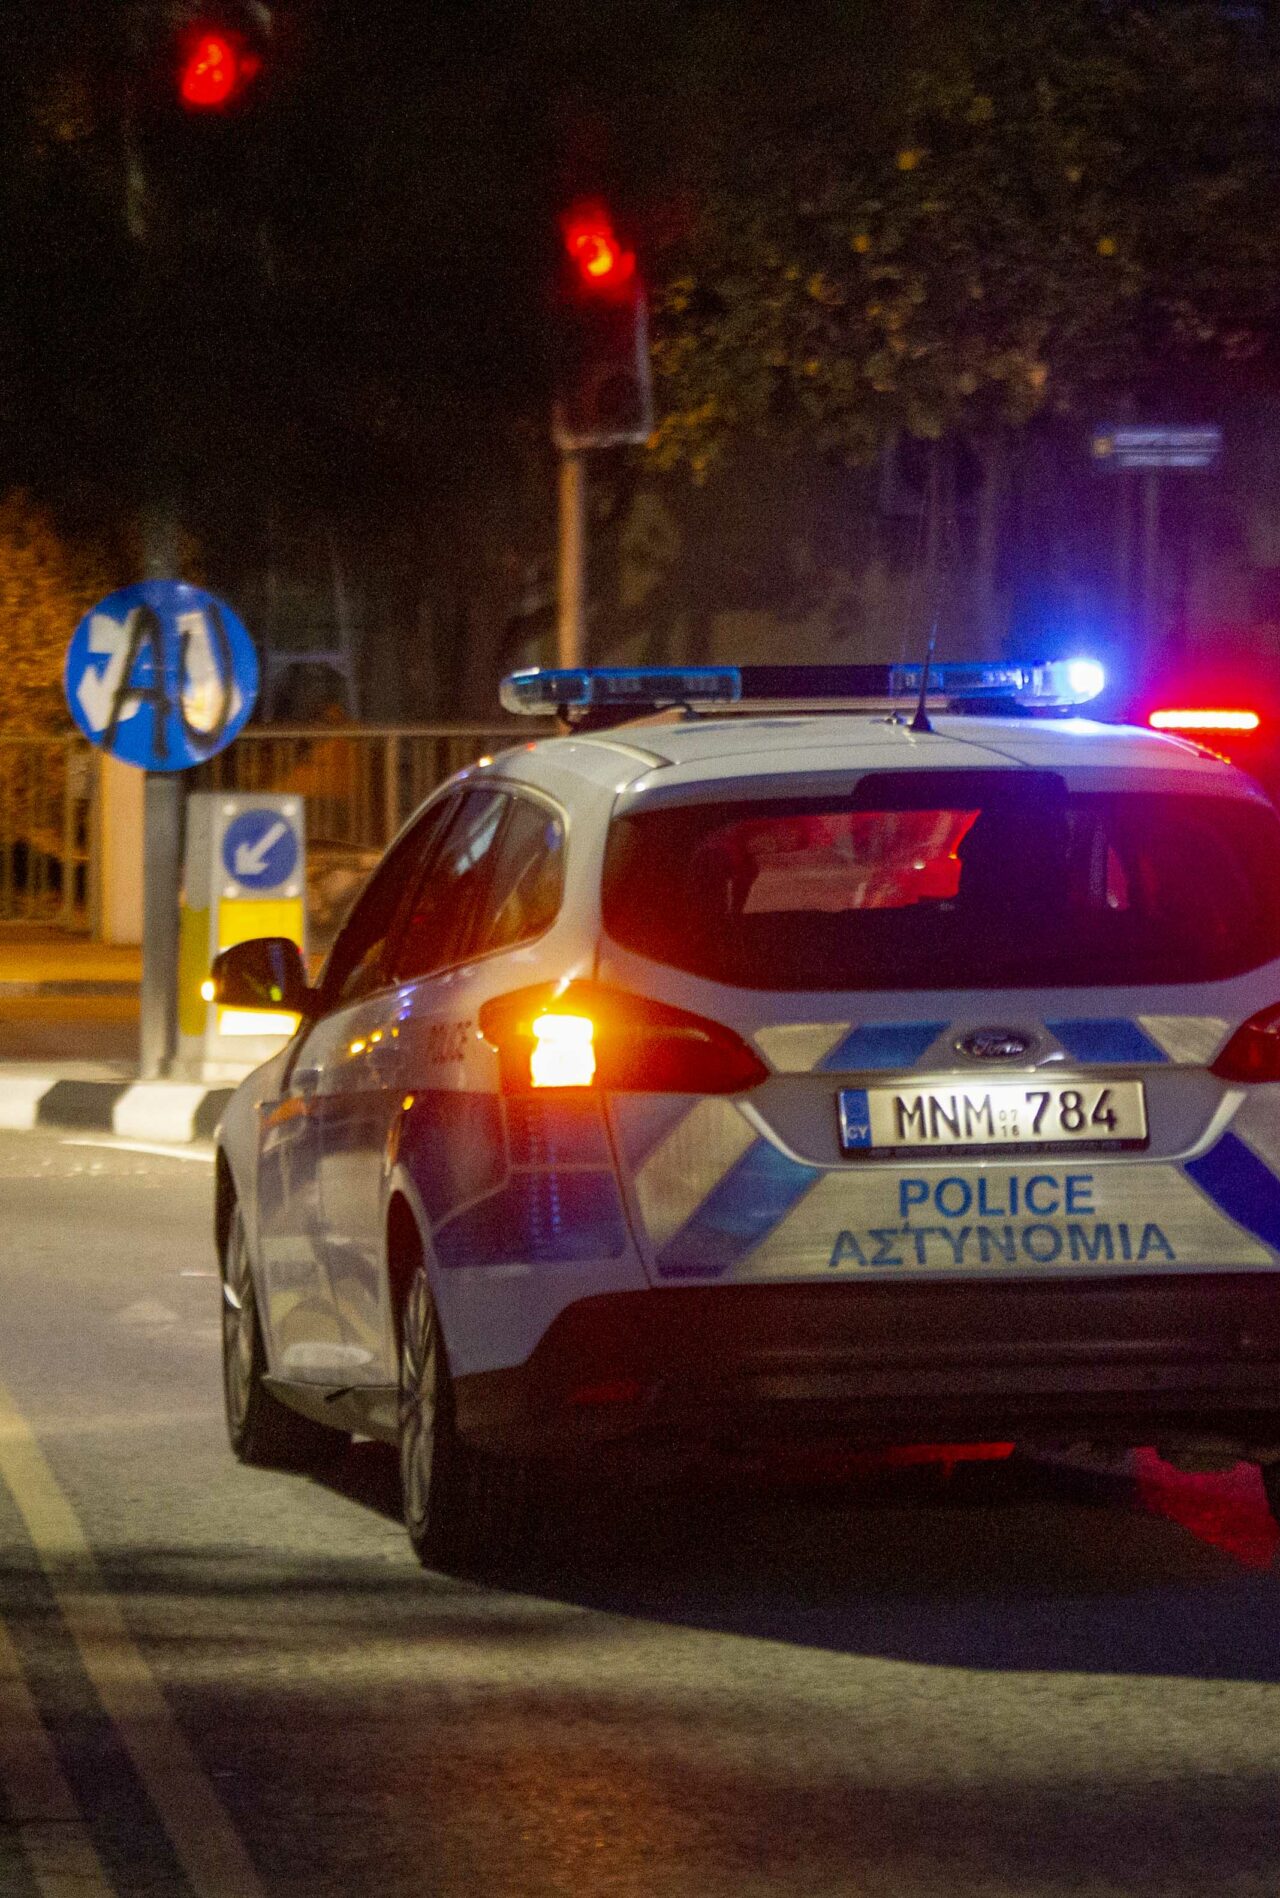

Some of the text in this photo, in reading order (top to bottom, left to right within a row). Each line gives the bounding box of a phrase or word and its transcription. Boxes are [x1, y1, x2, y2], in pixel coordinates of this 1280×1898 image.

[848, 1126, 868, 1140] CY
[895, 1089, 1117, 1139] MNM 784
[999, 1109, 1018, 1122] 07
[900, 1174, 1095, 1219] POLICE
[828, 1222, 1176, 1268] ΑΣΤΥΝΟΜΙΑ
